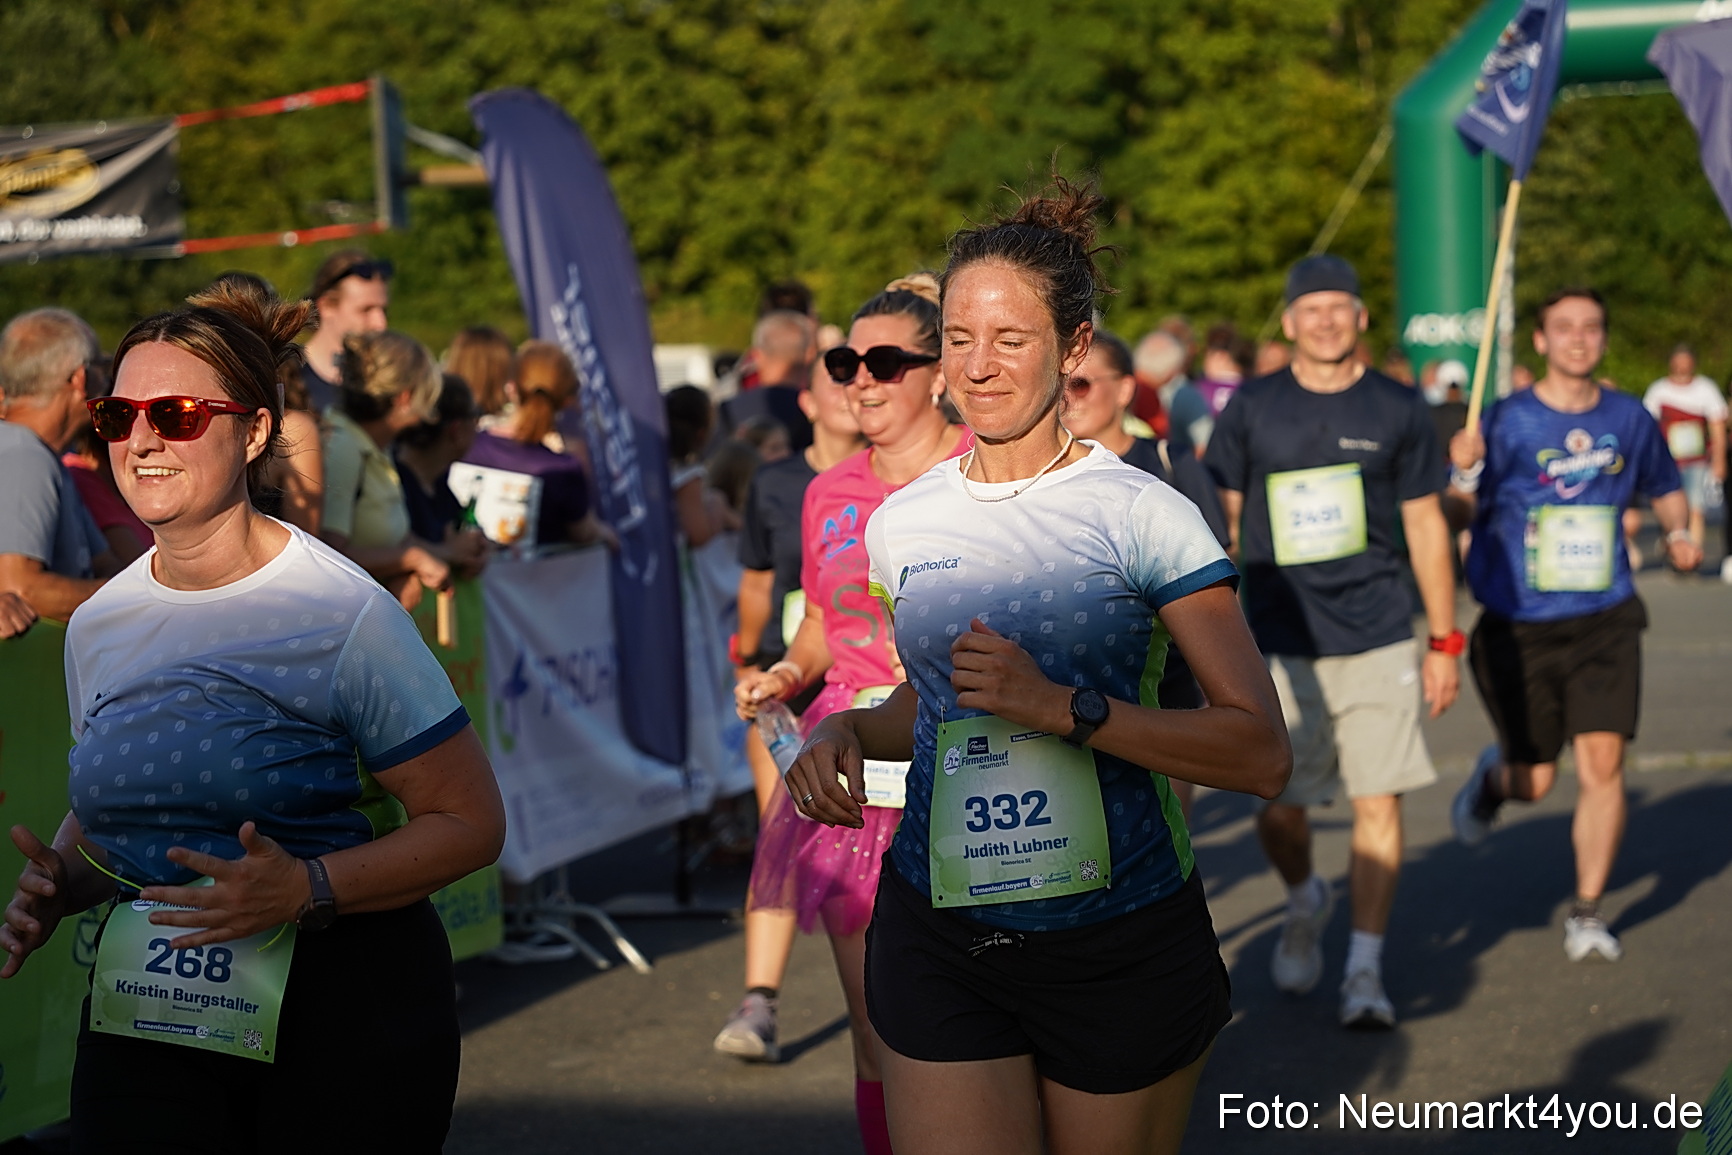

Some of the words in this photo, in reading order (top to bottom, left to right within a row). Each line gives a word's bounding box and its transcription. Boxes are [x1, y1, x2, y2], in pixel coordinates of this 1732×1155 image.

[909, 557, 959, 577] Bionorica
[961, 751, 1009, 767] Firmenlauf
[978, 760, 1010, 771] neumarkt
[965, 790, 1052, 833] 332
[963, 842, 1010, 859] Judith
[1014, 836, 1069, 855] Lubner
[972, 881, 1028, 895] firmenlauf.bayern
[145, 937, 233, 983] 268
[115, 979, 169, 1000] Kristin
[173, 988, 259, 1014] Burgstaller
